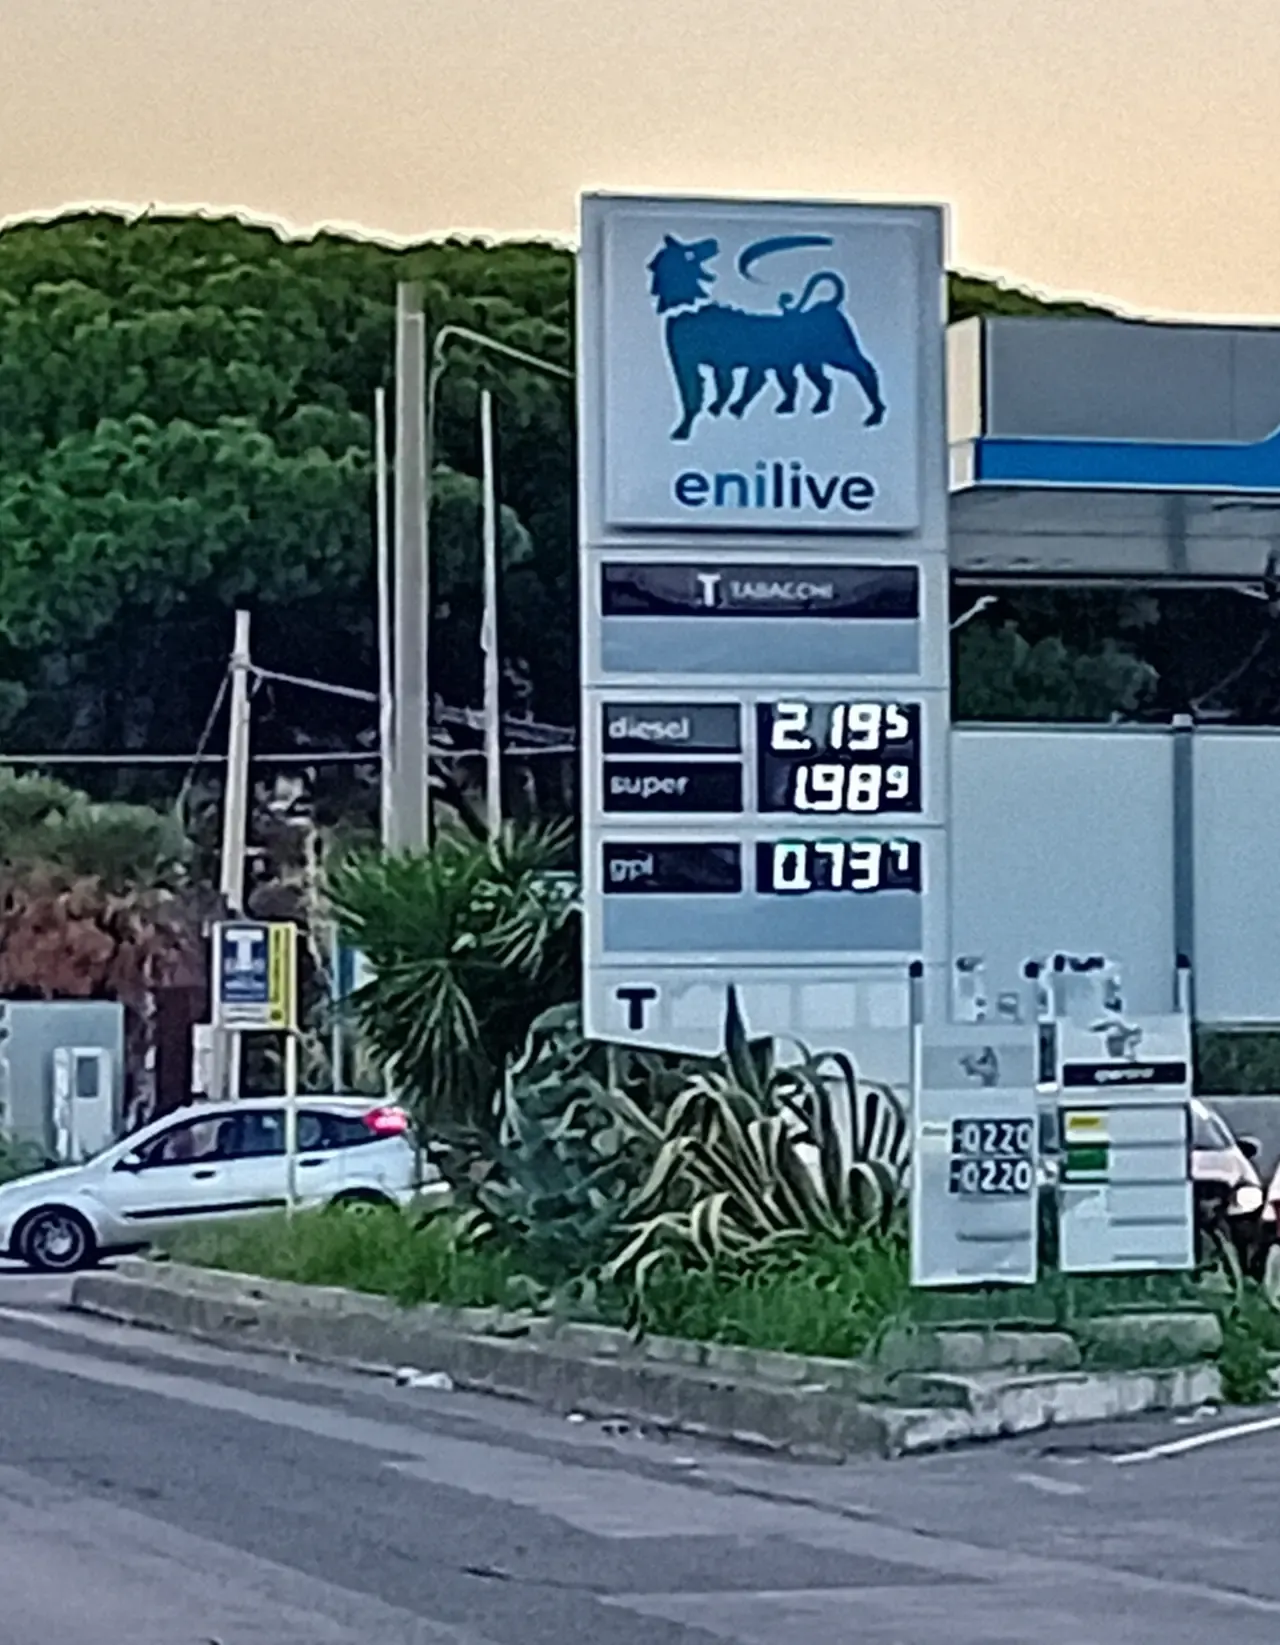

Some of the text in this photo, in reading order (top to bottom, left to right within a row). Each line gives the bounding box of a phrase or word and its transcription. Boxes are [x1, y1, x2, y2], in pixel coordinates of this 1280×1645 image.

[674, 461, 875, 510] enilive
[608, 716, 690, 740] diesel
[610, 775, 690, 799] super
[609, 852, 654, 882] gpl
[616, 987, 657, 1031] T
